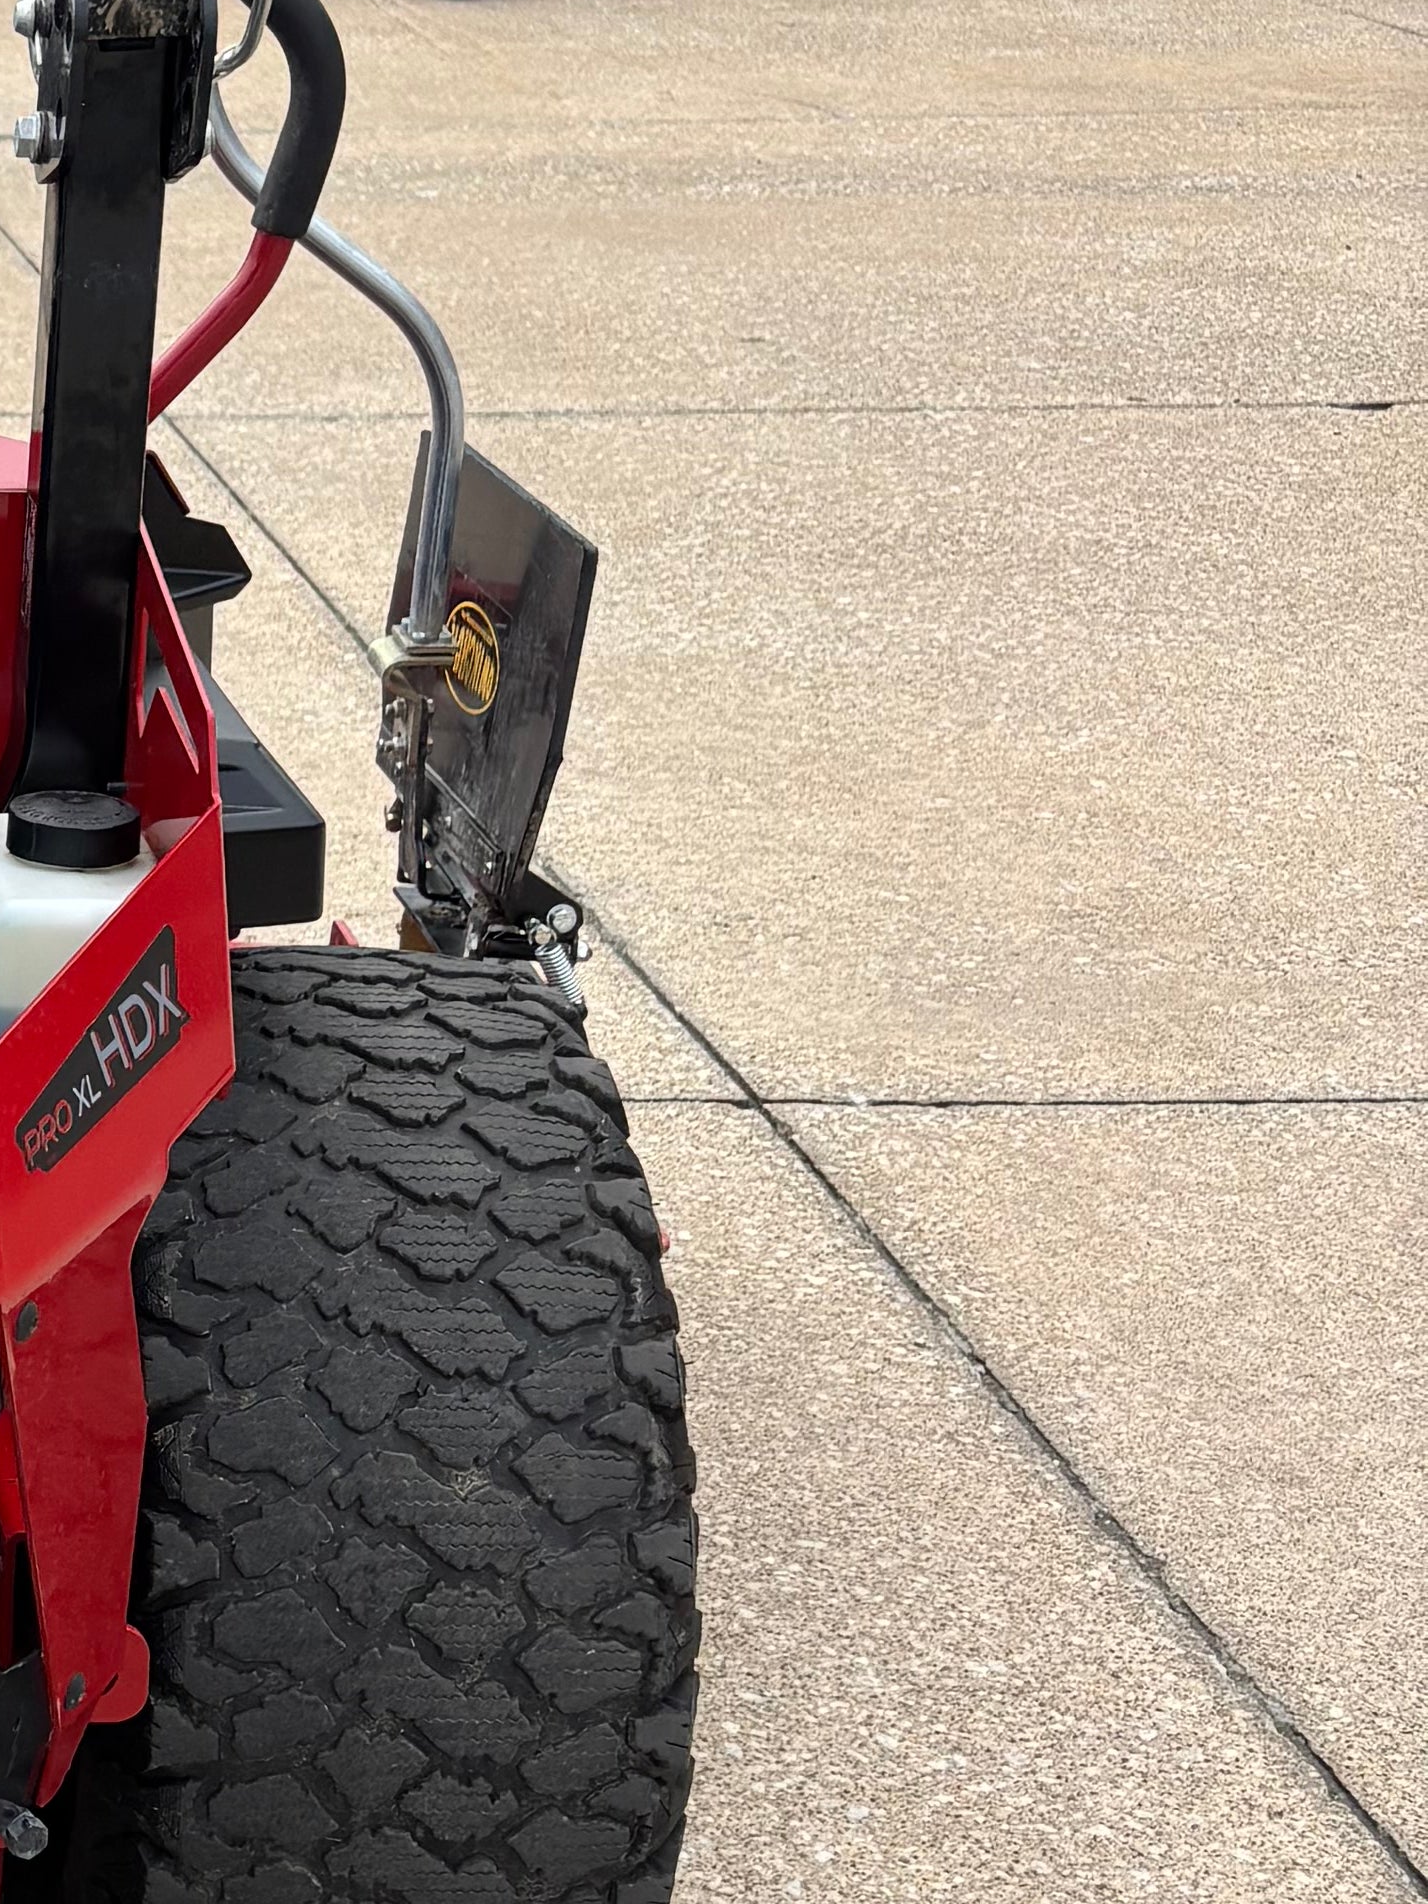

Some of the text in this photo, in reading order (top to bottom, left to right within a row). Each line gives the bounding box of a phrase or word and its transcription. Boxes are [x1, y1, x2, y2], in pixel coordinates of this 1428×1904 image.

[23, 962, 186, 1167] PRO XL HDX
